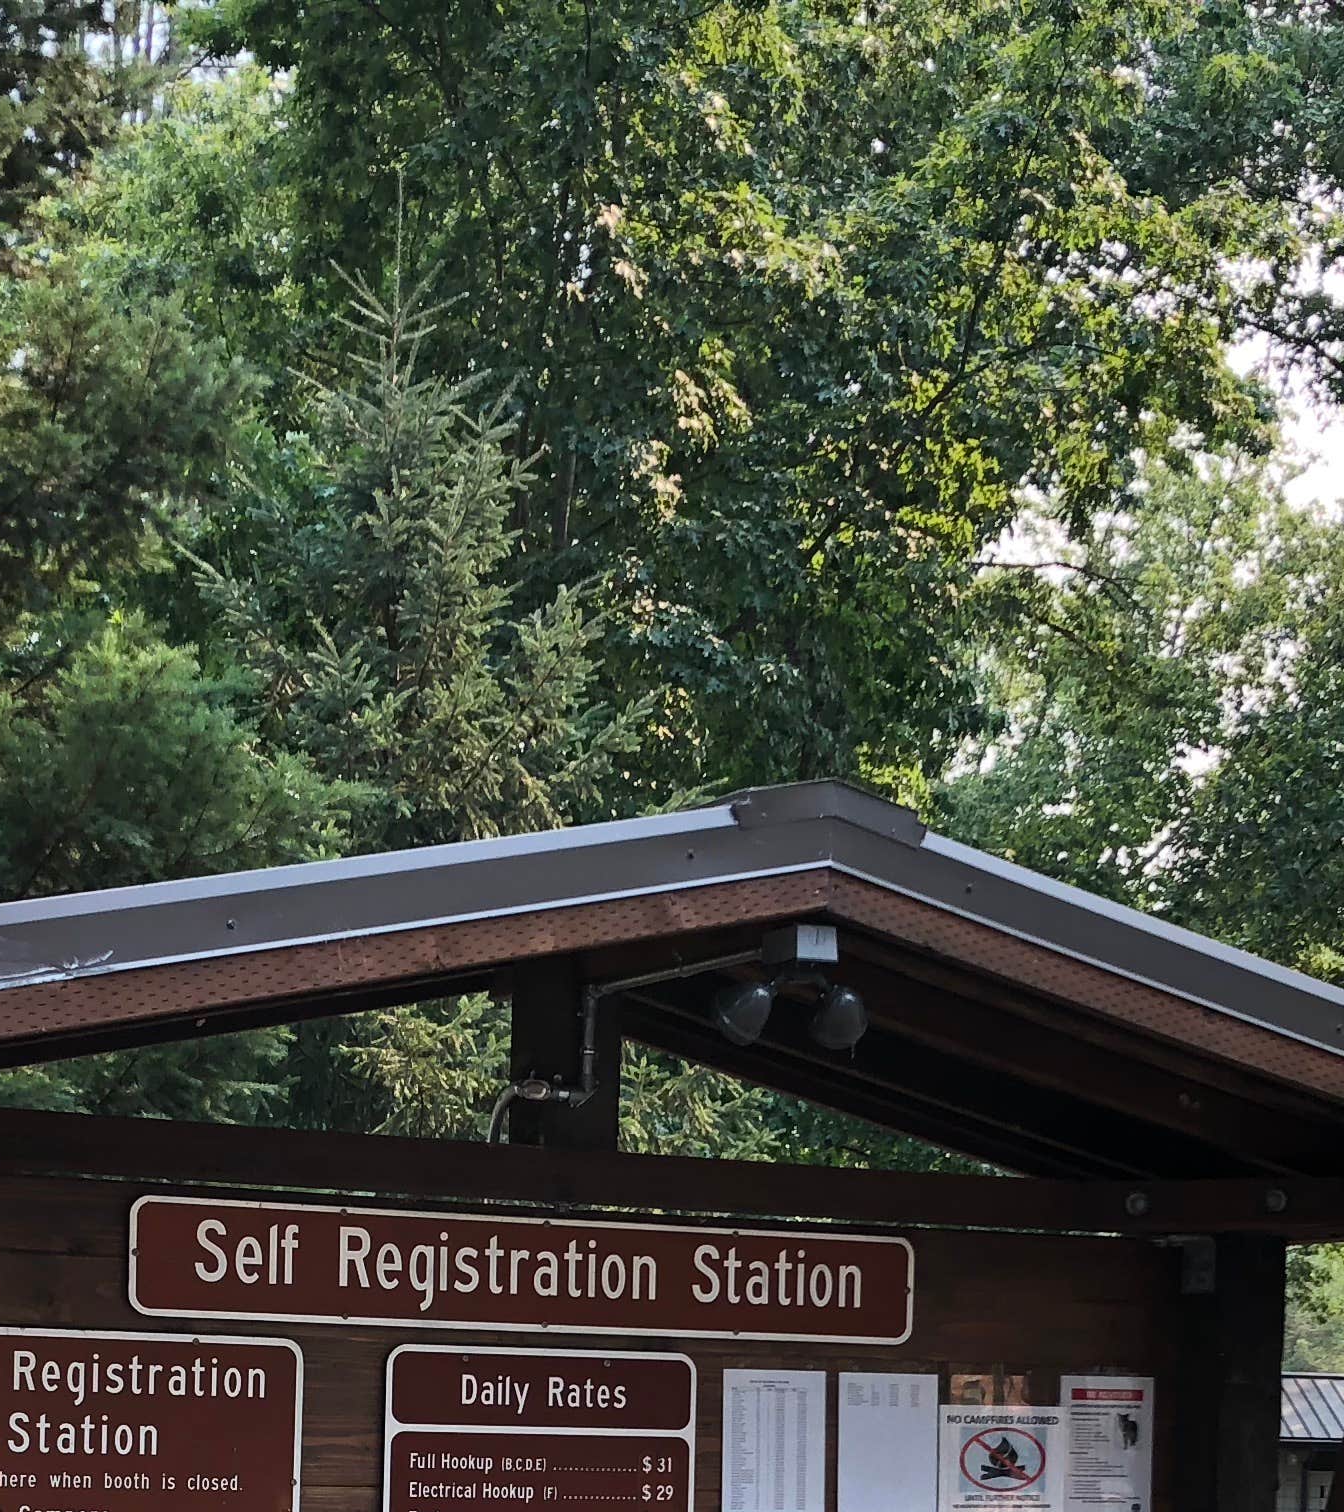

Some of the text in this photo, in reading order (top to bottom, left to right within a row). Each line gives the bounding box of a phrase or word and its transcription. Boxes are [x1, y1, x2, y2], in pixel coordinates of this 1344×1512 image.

[195, 1219, 865, 1311] Self Registration Station
[13, 1350, 268, 1406] Registration
[462, 1374, 626, 1414] Daily Rates
[8, 1412, 157, 1455] Station
[947, 1415, 1059, 1425] NO CAMPFIRES ALLOWED
[410, 1453, 435, 1468] Full
[441, 1453, 493, 1474] Hookup
[642, 1456, 652, 1474] $
[657, 1457, 672, 1472] 31
[0, 1471, 36, 1487] here
[50, 1472, 91, 1488] when
[104, 1473, 149, 1489] booth
[162, 1473, 175, 1490] is
[188, 1474, 243, 1491] closed.
[409, 1482, 673, 1503] Electrical Hookup (F) $ 29
